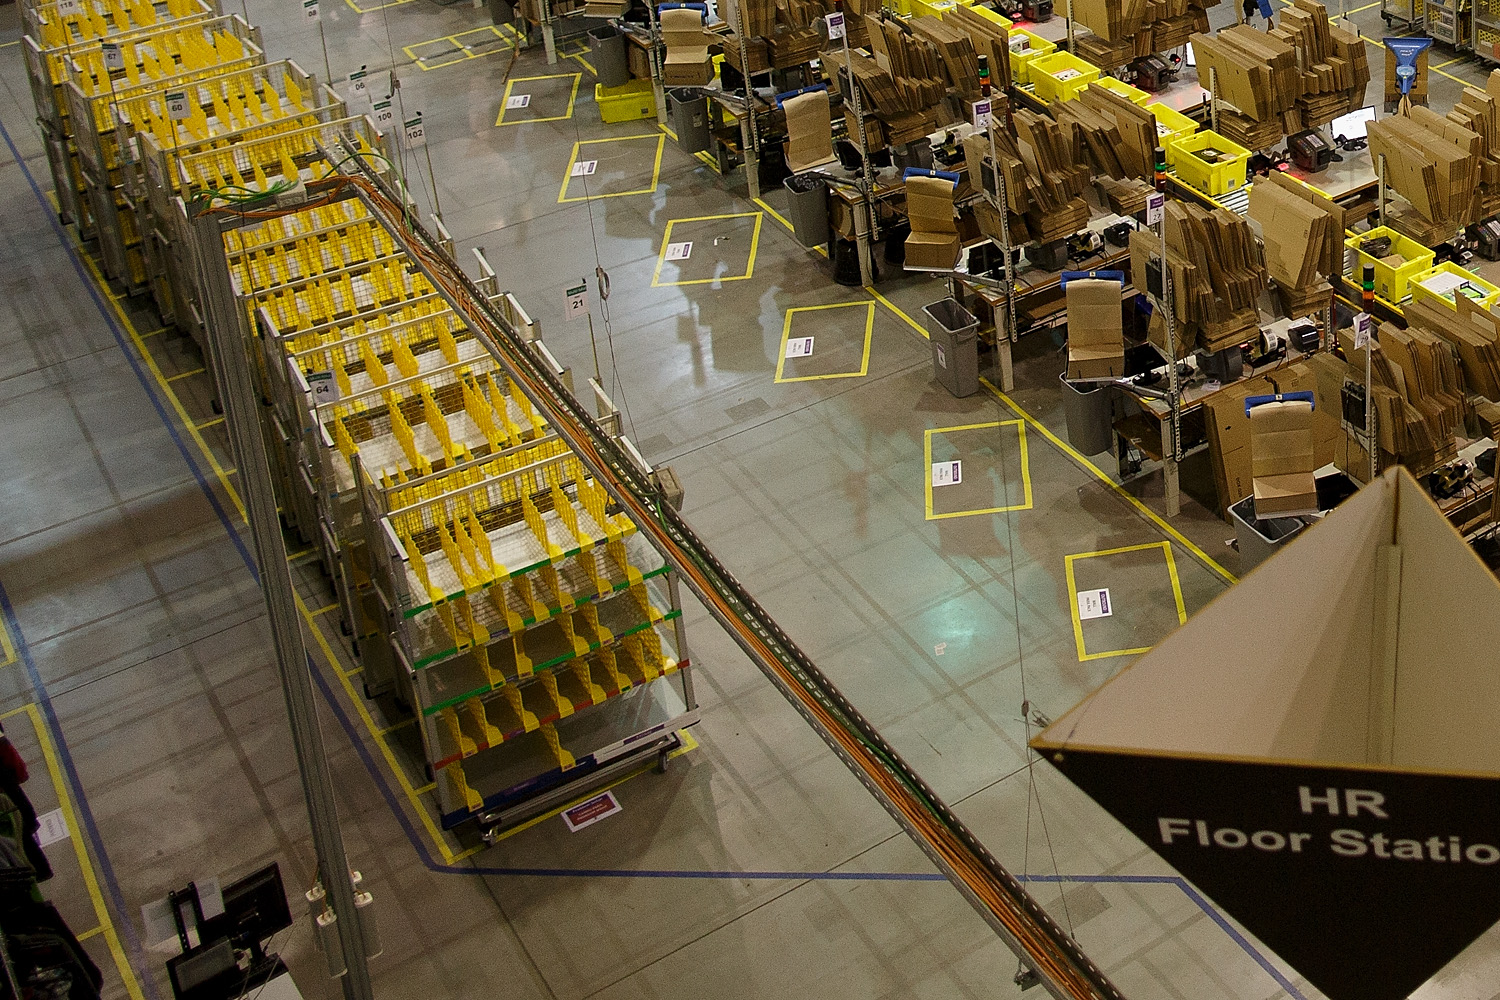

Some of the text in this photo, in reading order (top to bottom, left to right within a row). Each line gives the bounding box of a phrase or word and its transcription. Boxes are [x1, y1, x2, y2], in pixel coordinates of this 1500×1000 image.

[378, 112, 392, 121] 100
[407, 129, 423, 139] 102
[572, 299, 584, 309] 21
[316, 385, 329, 394] 64
[1298, 785, 1390, 820] HR
[1158, 816, 1311, 854] Floor
